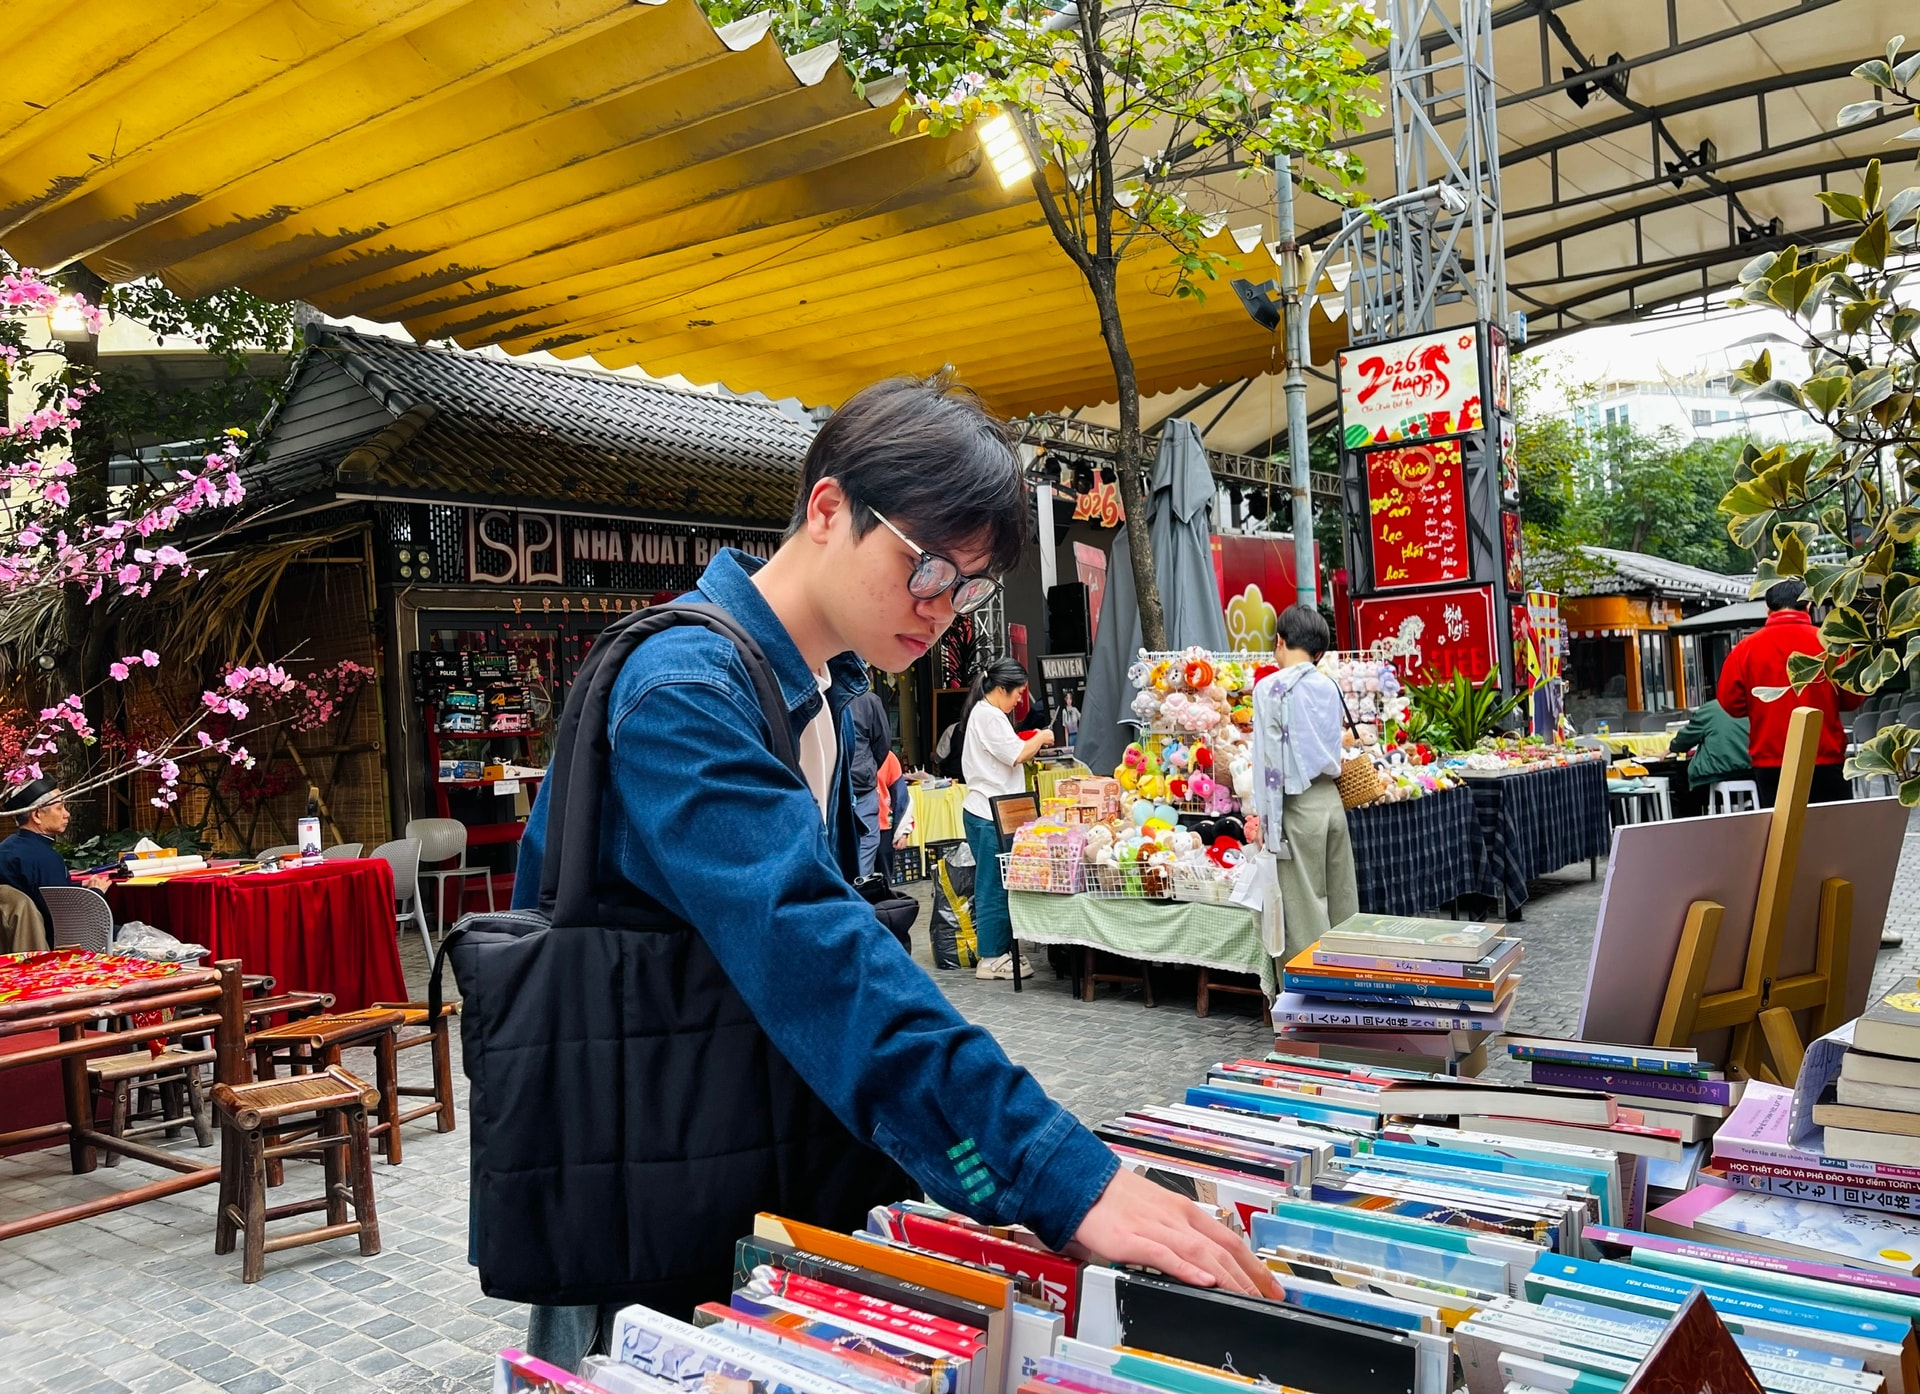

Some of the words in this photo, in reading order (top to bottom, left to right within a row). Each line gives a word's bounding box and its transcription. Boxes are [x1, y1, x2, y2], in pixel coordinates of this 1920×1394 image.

[1357, 343, 1417, 404] 2026
[1072, 483, 1119, 528] 026
[573, 527, 623, 561] NHÀ
[1730, 1162, 1749, 1172] HỌC
[1750, 1164, 1772, 1175] THẬT
[1774, 1166, 1791, 1176] GIỎI
[1793, 1168, 1805, 1177] VÀ
[1806, 1170, 1824, 1180] PHÁ
[1846, 1176, 1864, 1185] 9-10
[1707, 1294, 1723, 1302] NGÂ
